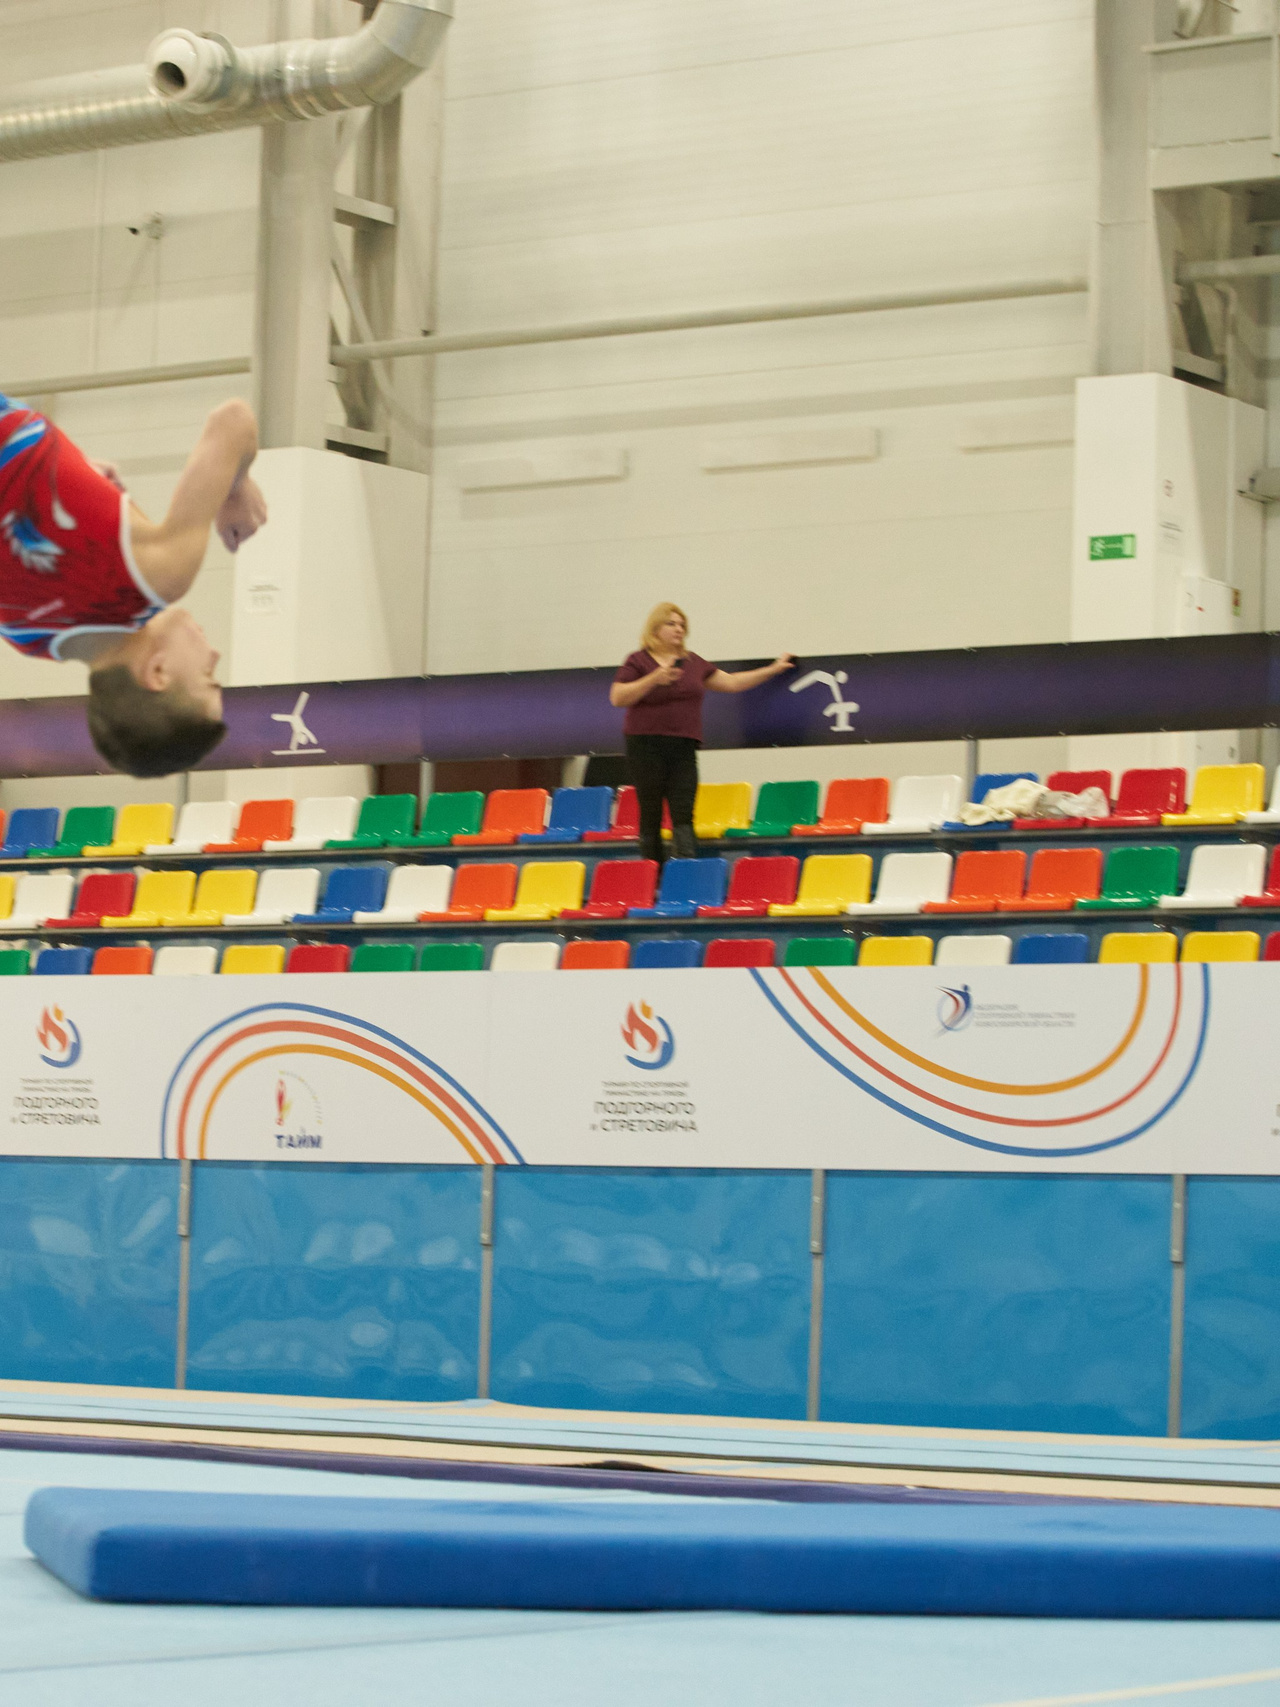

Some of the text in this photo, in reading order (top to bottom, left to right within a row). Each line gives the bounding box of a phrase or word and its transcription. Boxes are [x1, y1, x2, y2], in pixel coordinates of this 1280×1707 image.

[13, 1097, 99, 1109] ПОДГОРНОГО
[594, 1101, 696, 1115] ПОДГОРНОГО
[20, 1113, 101, 1125] СТРЕТОВИЧА
[600, 1119, 699, 1133] СТРЕТОВИЧА
[275, 1127, 323, 1149] ТАЙМ
